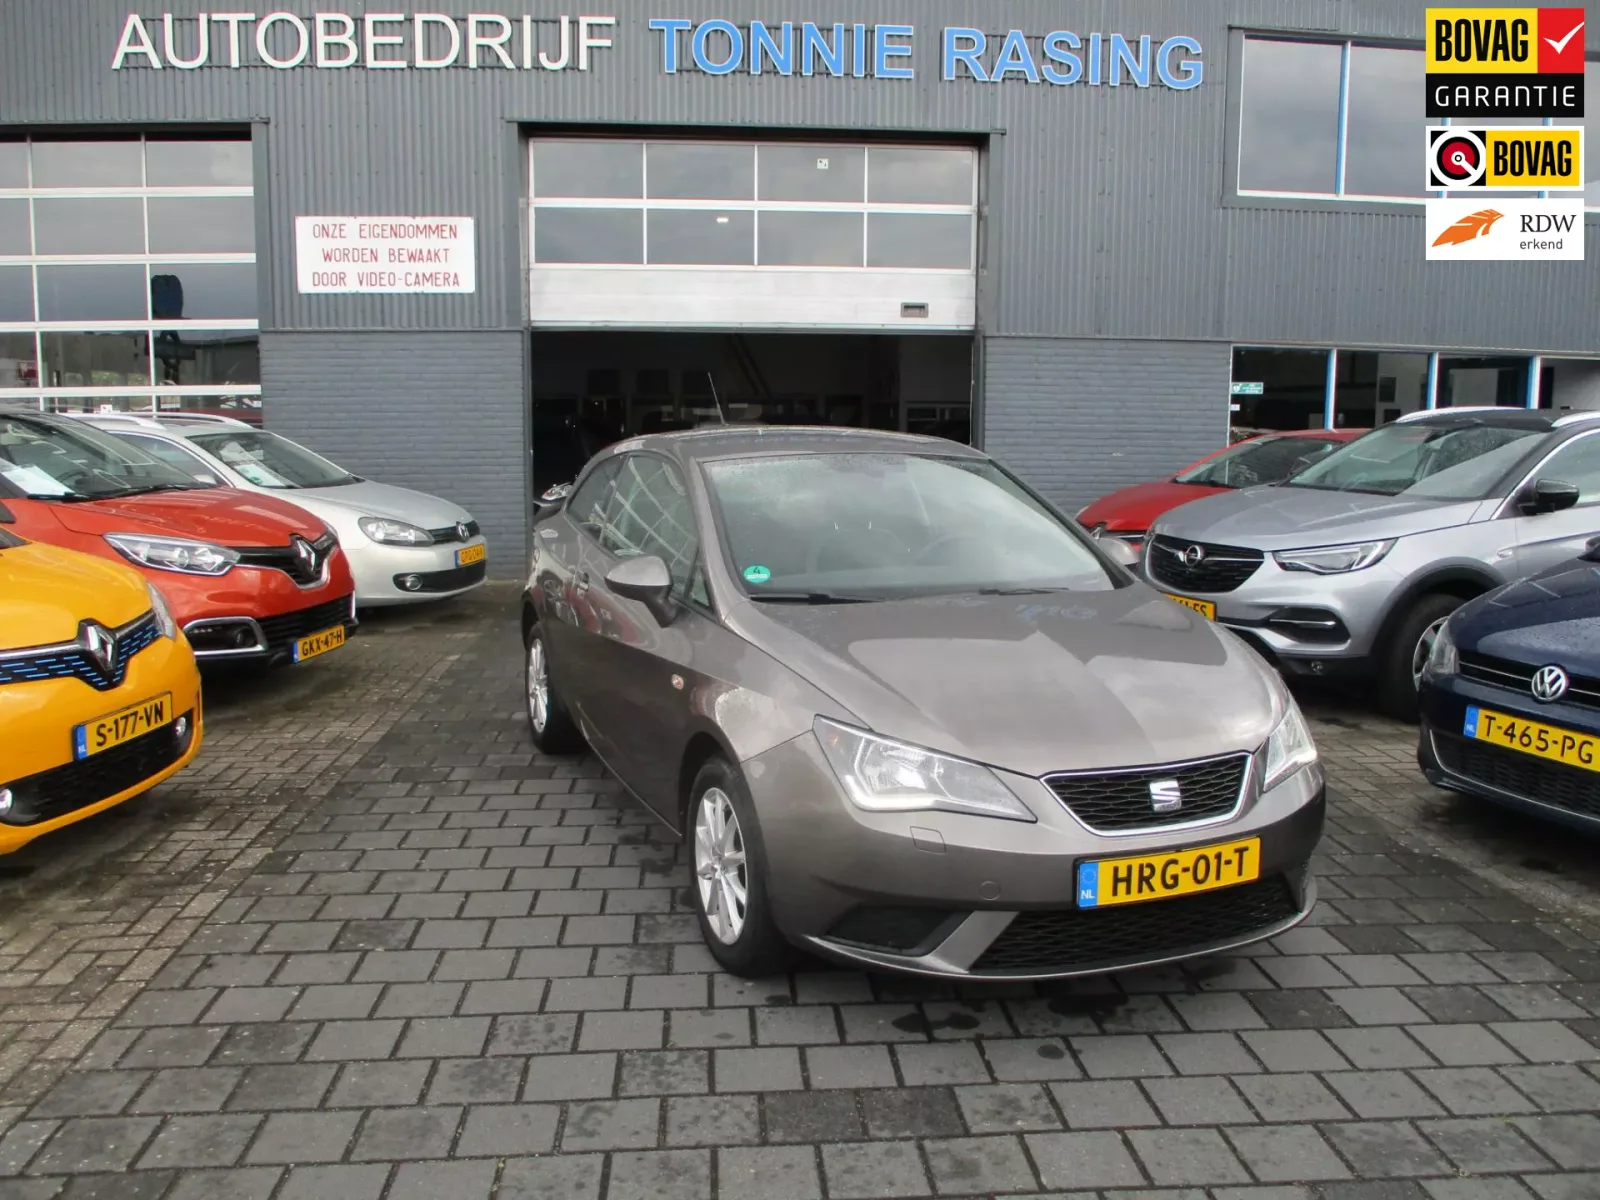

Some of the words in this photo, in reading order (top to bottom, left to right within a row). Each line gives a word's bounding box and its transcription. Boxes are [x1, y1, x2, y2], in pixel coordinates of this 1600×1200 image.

[111, 12, 616, 71] AUTOBEDRIJF
[649, 18, 914, 80] TONNIE
[943, 27, 1204, 90] RASING
[312, 223, 347, 239] ONZE
[358, 223, 458, 239] EIGENDOMMEN
[322, 247, 379, 263] WORDEN
[388, 247, 451, 263] BEWAAKT
[312, 271, 347, 287] DOOR
[357, 271, 460, 287] VIDEO-CAMERA
[302, 629, 343, 656] GKX-47-H
[96, 701, 164, 747] S-177-VN
[1484, 714, 1594, 764] T-465-PG
[1111, 846, 1249, 897] HRG-01-T
[1080, 889, 1095, 900] NL
